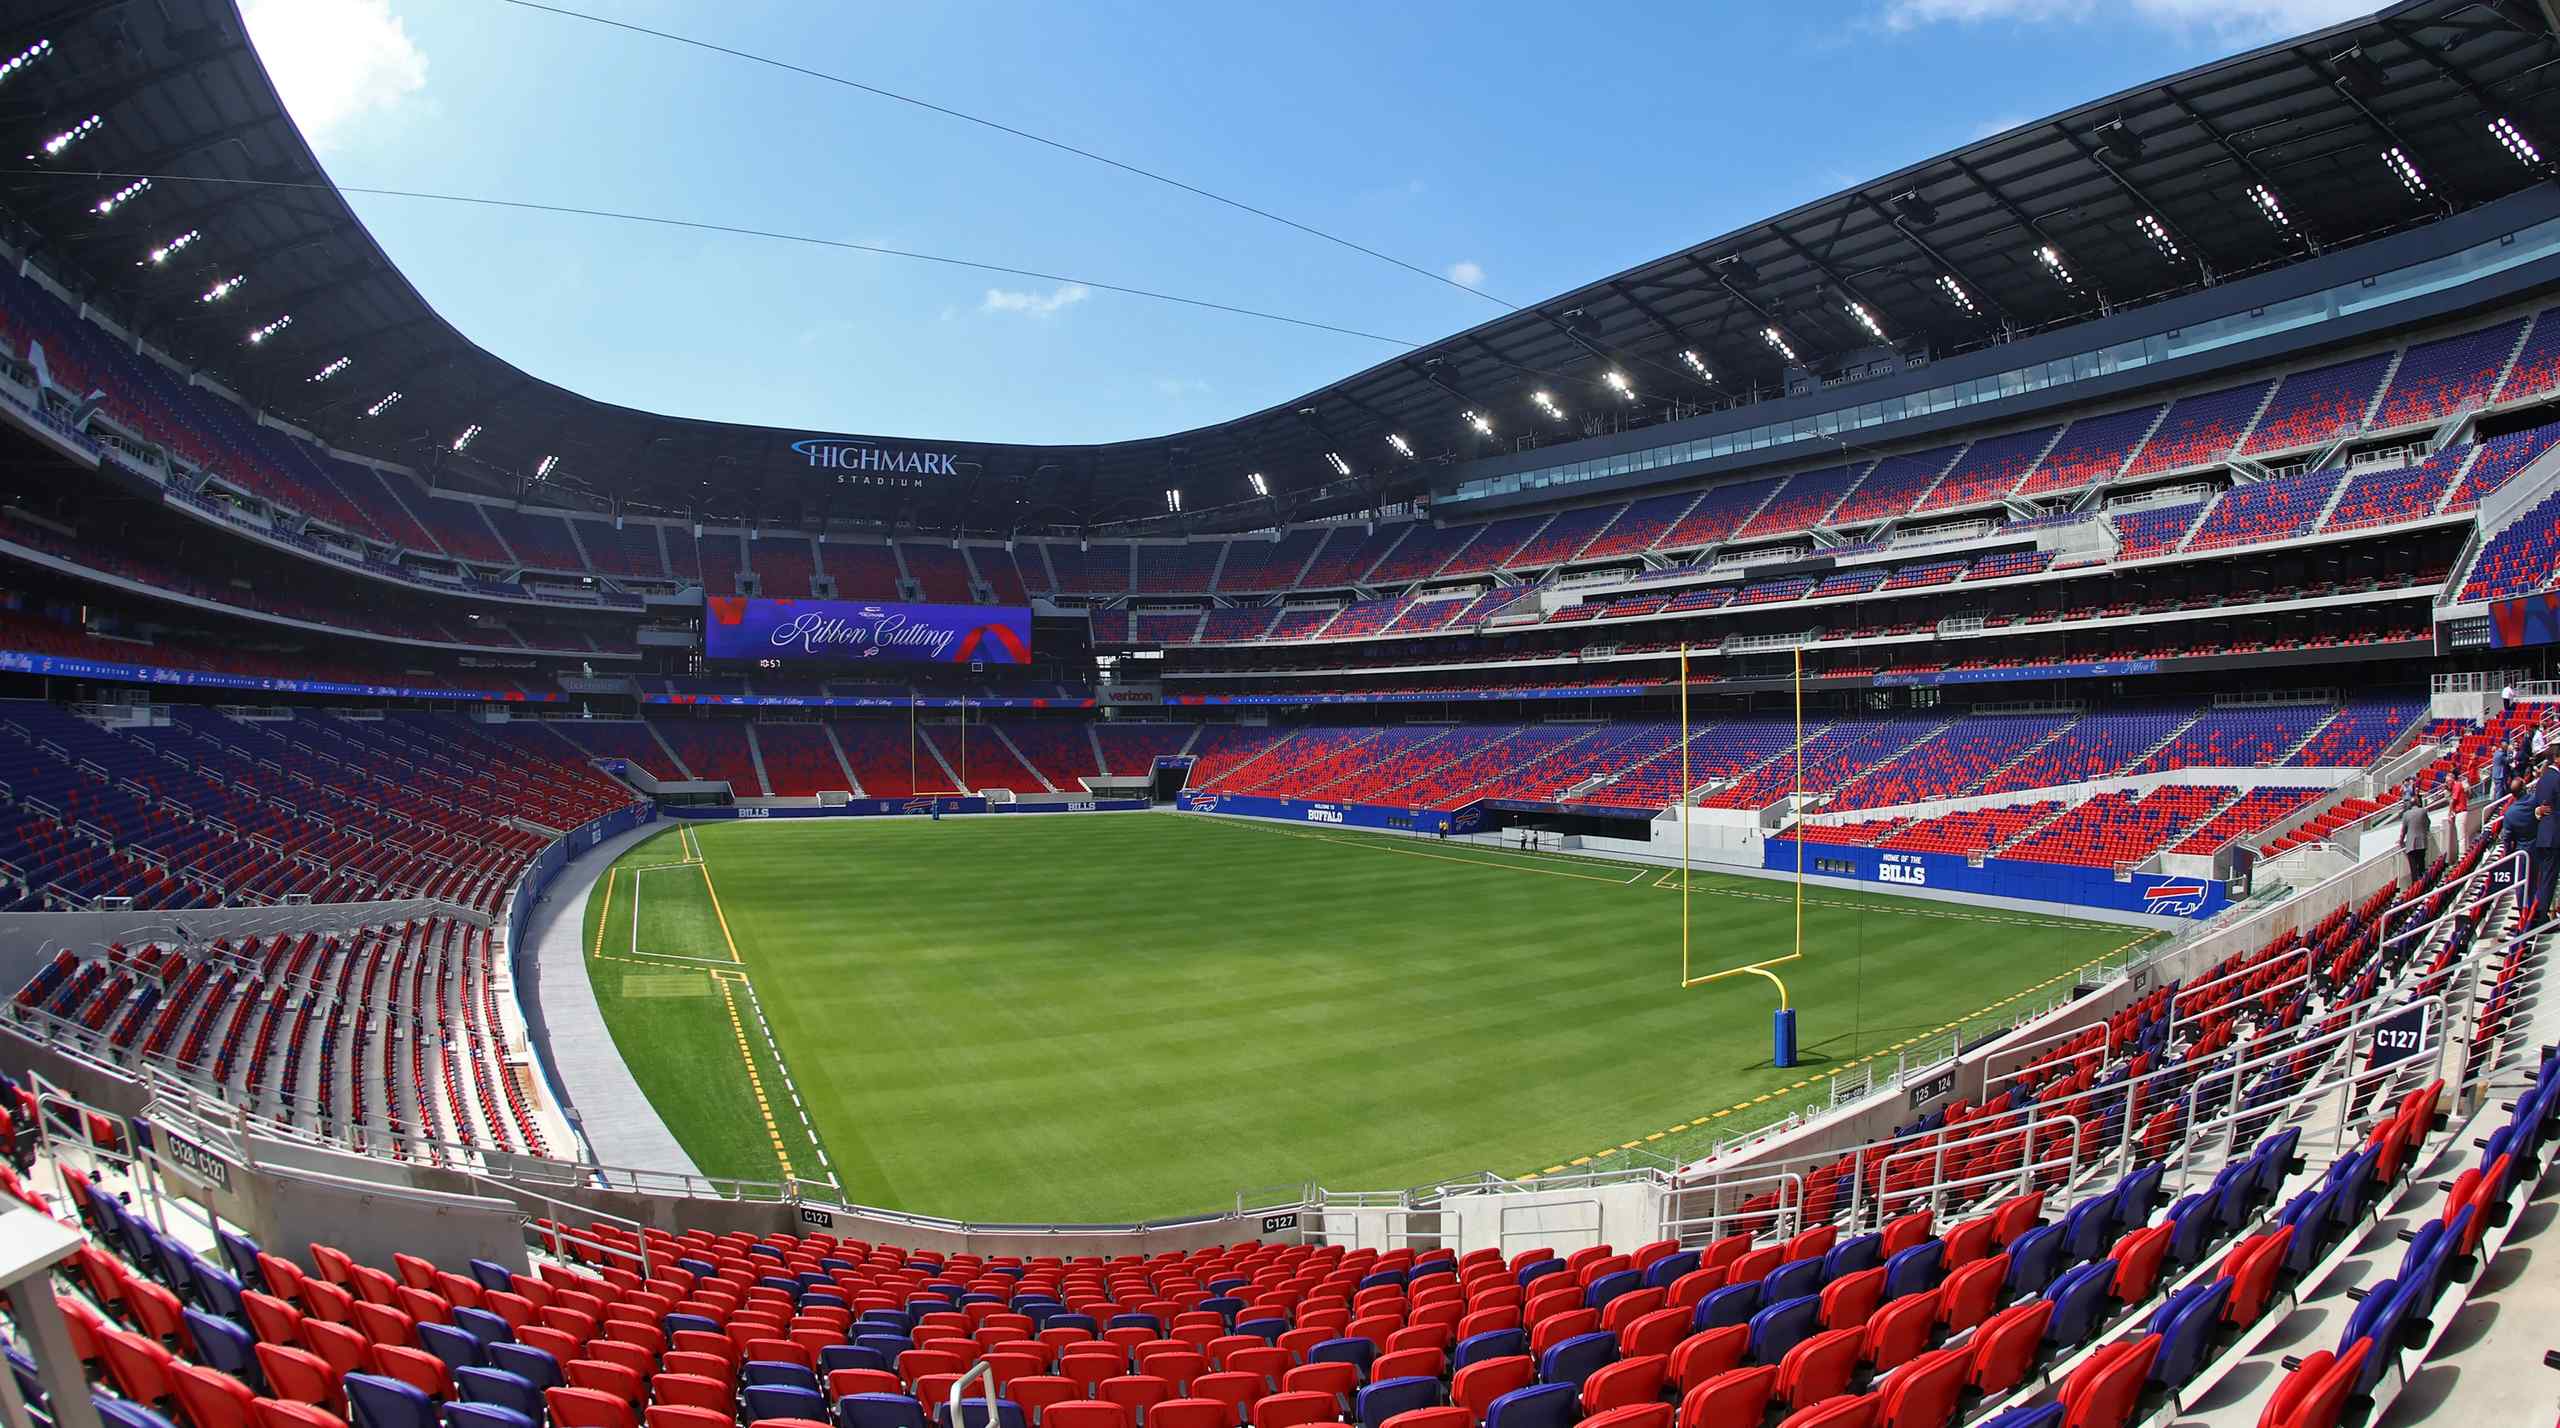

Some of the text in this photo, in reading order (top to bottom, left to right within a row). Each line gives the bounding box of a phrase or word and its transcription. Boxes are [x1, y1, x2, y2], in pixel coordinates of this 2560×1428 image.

[810, 444, 957, 475] HIGHMARK
[838, 475, 923, 488] STADIUM
[771, 611, 955, 657] Ribbon Cutting
[1109, 690, 1153, 702] verizon
[738, 808, 769, 818] BILLS
[1068, 802, 1096, 811] BILLS
[1308, 809, 1343, 823] BUFFALO
[1883, 853, 1900, 862] HOME
[1911, 855, 1922, 864] THE
[1879, 863, 1925, 885] BILLS
[2493, 871, 2511, 883] 125
[2377, 1029, 2418, 1049] C127
[1916, 1074, 1951, 1102] 125 124
[199, 1153, 225, 1183] C127
[804, 1210, 829, 1224] C127
[1266, 1215, 1293, 1229] C127
